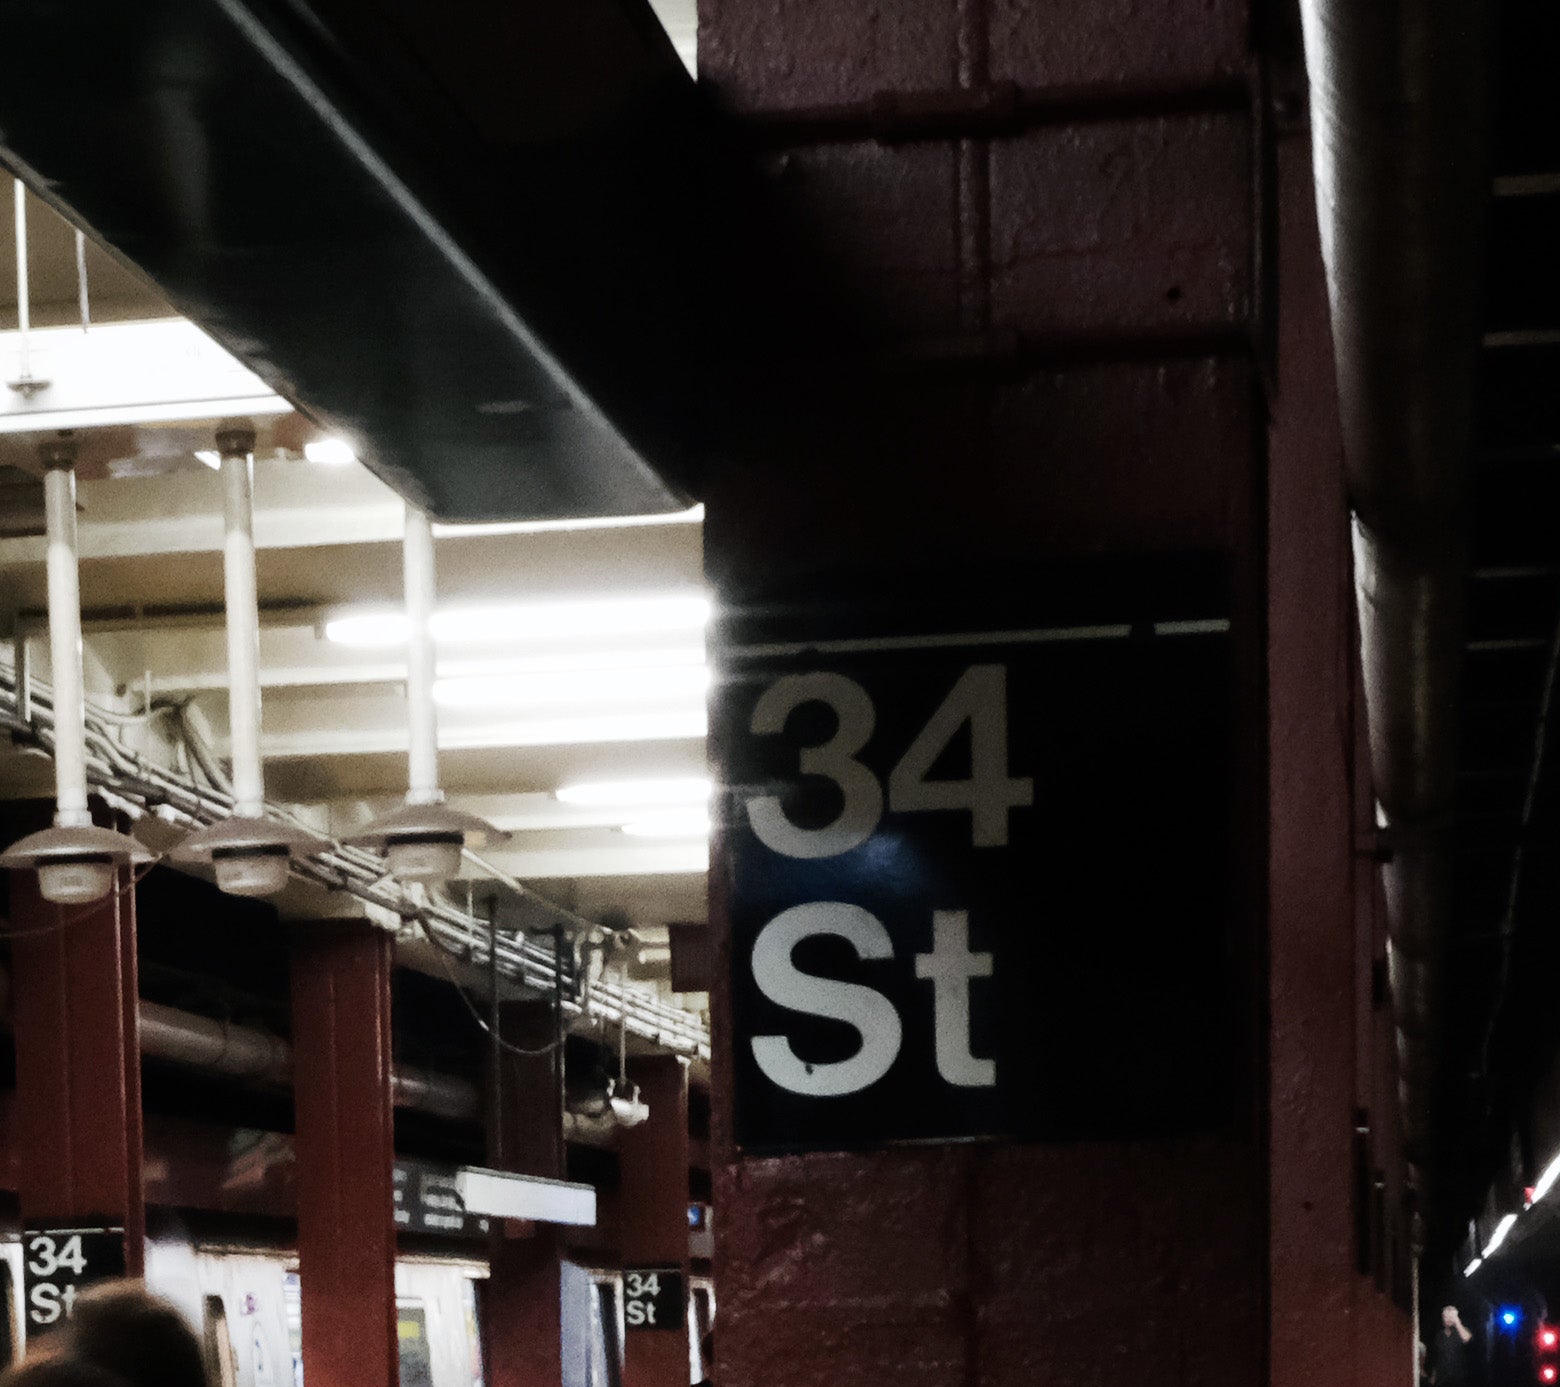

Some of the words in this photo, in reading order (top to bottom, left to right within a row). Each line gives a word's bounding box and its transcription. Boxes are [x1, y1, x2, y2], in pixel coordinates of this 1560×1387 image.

[746, 662, 1035, 859] 34
[749, 900, 998, 1099] St
[29, 1235, 88, 1277] 34
[30, 1282, 77, 1324] St
[626, 1272, 661, 1298] 34
[626, 1300, 657, 1325] St
